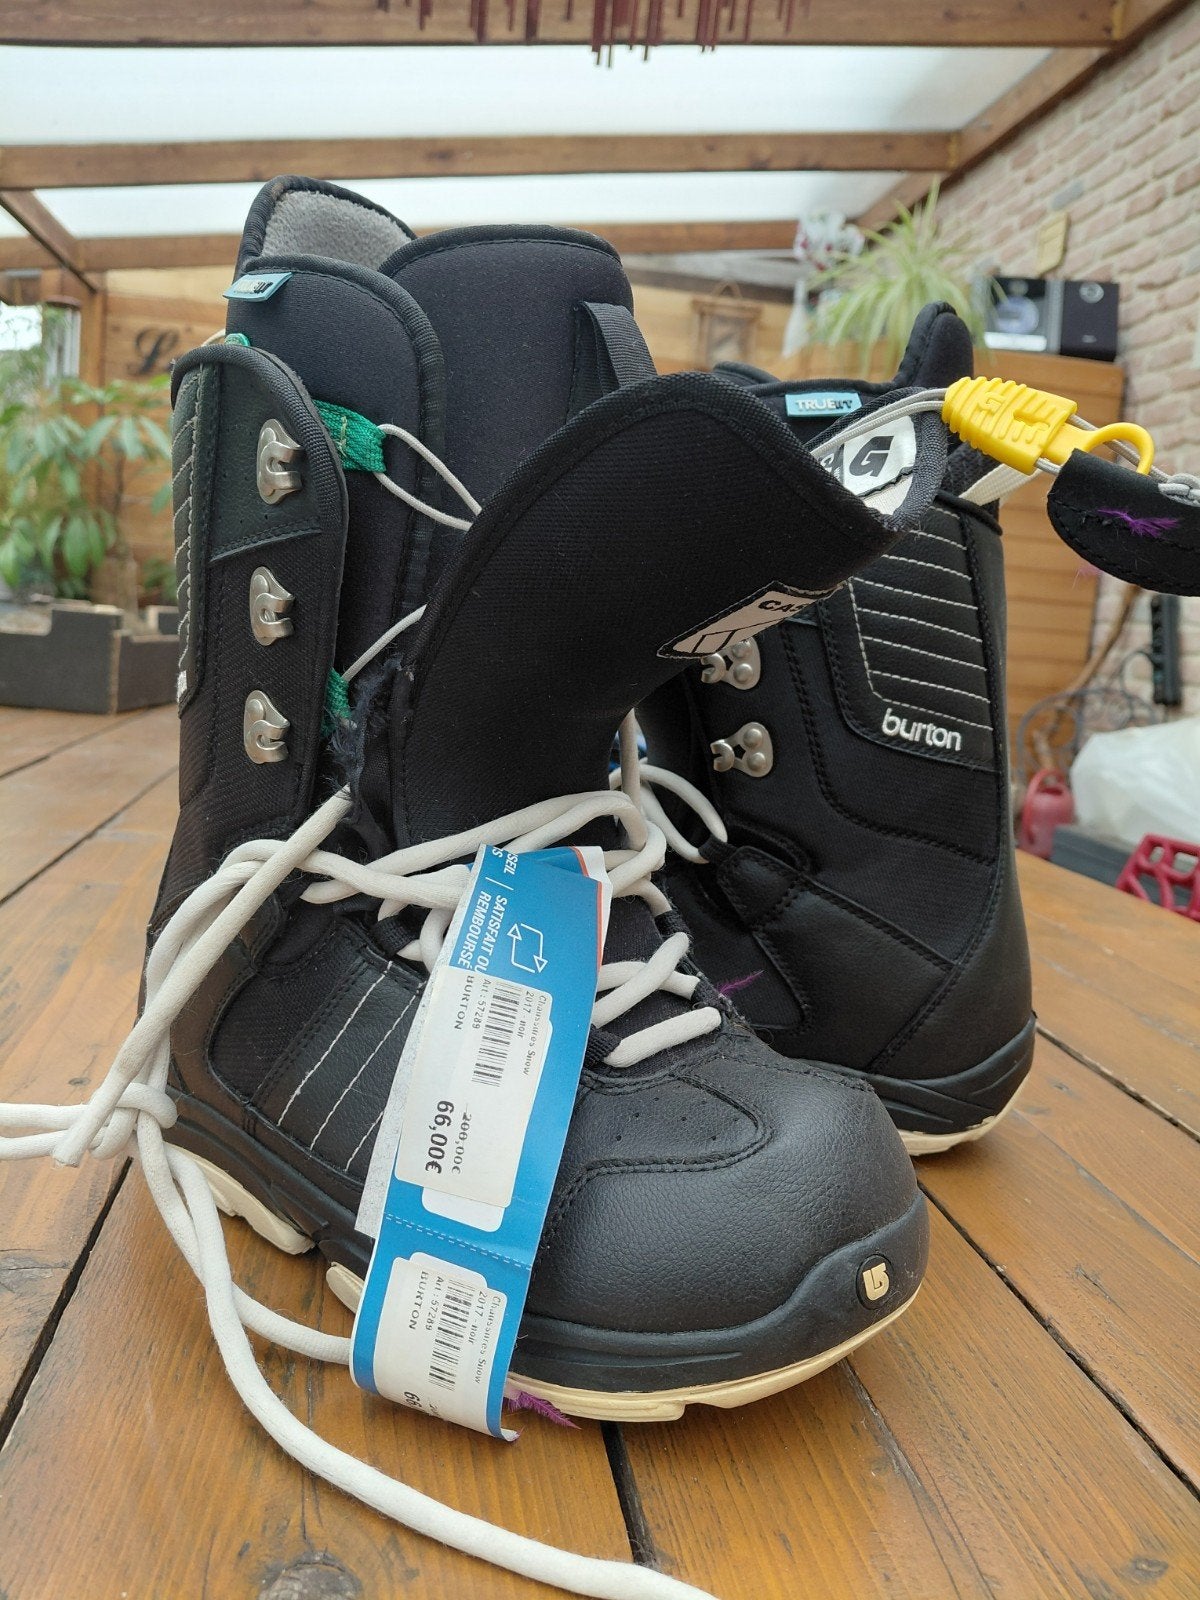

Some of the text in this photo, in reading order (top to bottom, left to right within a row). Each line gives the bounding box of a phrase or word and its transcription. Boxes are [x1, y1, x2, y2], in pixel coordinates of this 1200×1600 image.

[882, 708, 961, 751] burton
[503, 853, 519, 875] SEIL
[458, 891, 492, 970] REMBOURSÉ
[481, 895, 507, 956] SATISFAIT
[472, 1000, 487, 1029] 57289
[522, 990, 535, 1014] 2017
[425, 1100, 454, 1174] 66,00€
[425, 1300, 439, 1331] 57289
[476, 1290, 488, 1317] 2017
